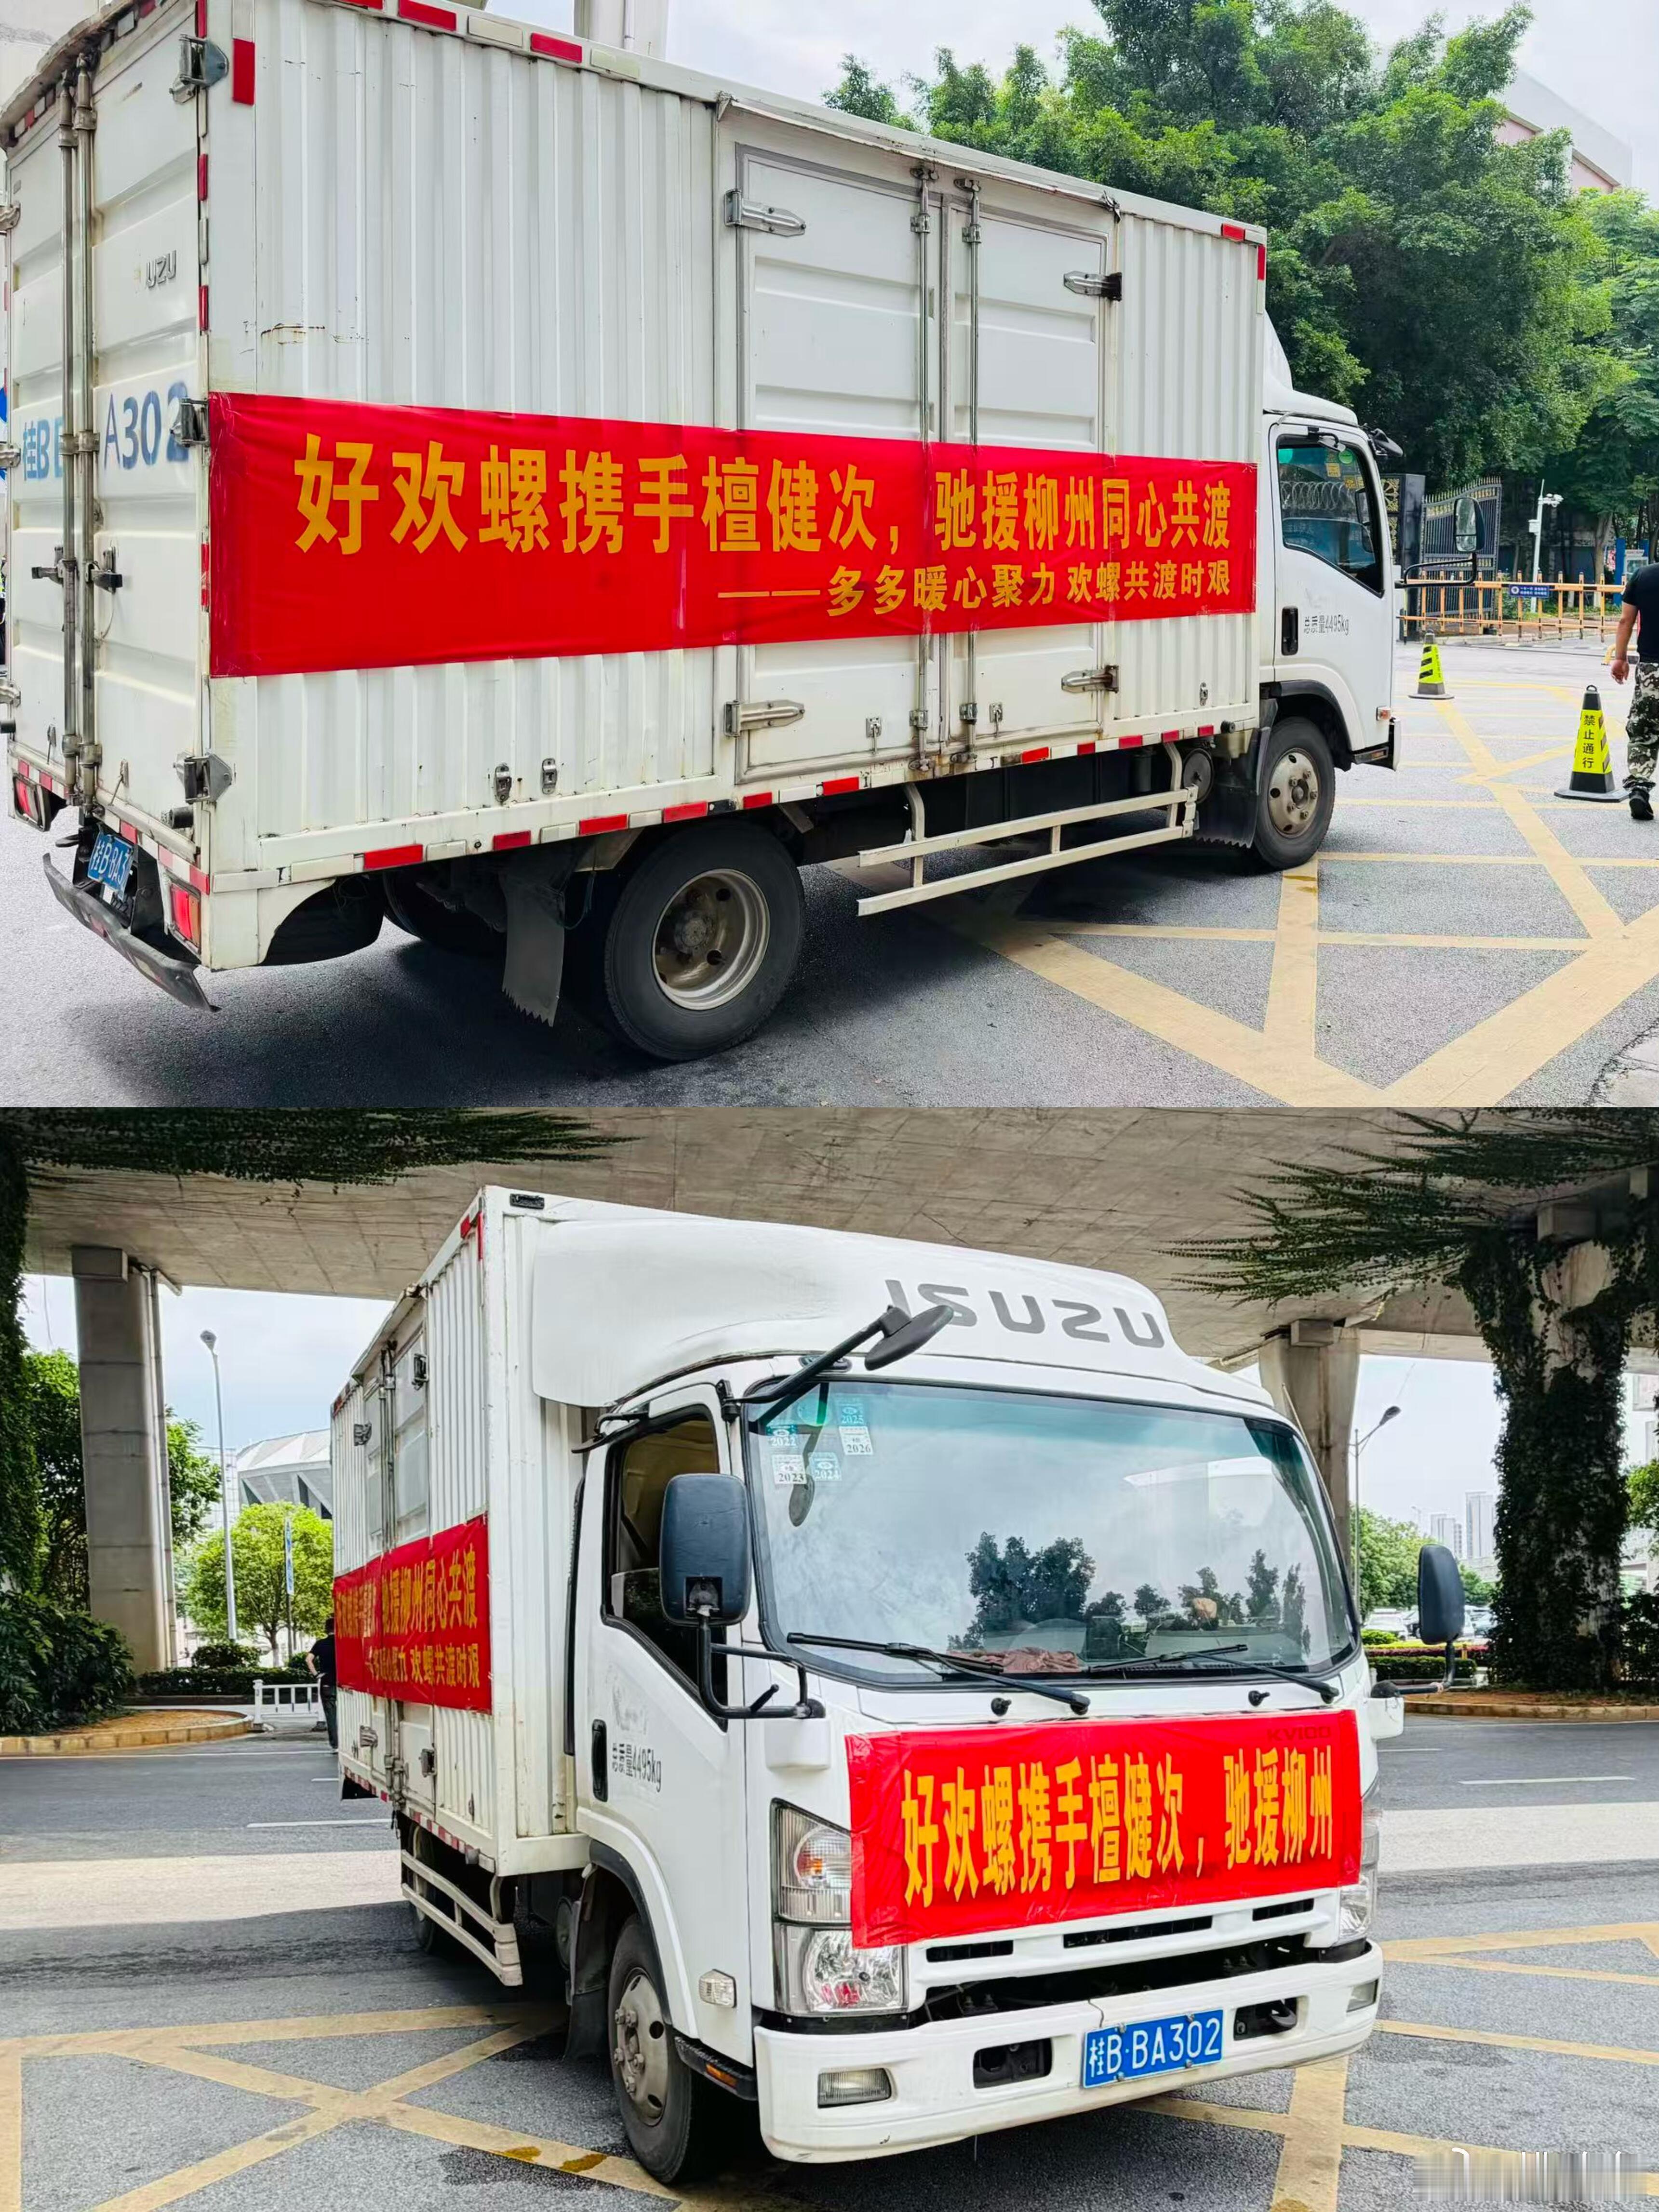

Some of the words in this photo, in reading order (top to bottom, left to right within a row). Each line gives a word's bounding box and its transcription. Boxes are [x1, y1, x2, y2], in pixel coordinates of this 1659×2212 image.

[294, 433, 1231, 555] 好欢螺携手檀健次，驰援柳州同心共渡
[1066, 560, 1230, 604] 欢螺共渡时艰
[1582, 715, 1595, 768] 禁止通行
[885, 1279, 1165, 1348] ISUZU
[771, 1437, 796, 1446] 2022
[847, 1444, 871, 1453] 2026
[778, 1473, 804, 1482] 2023
[901, 1745, 1332, 1907] 好欢螺携手檀健次，驰援柳州
[1089, 2018, 1220, 2078] 桂B·BA302
